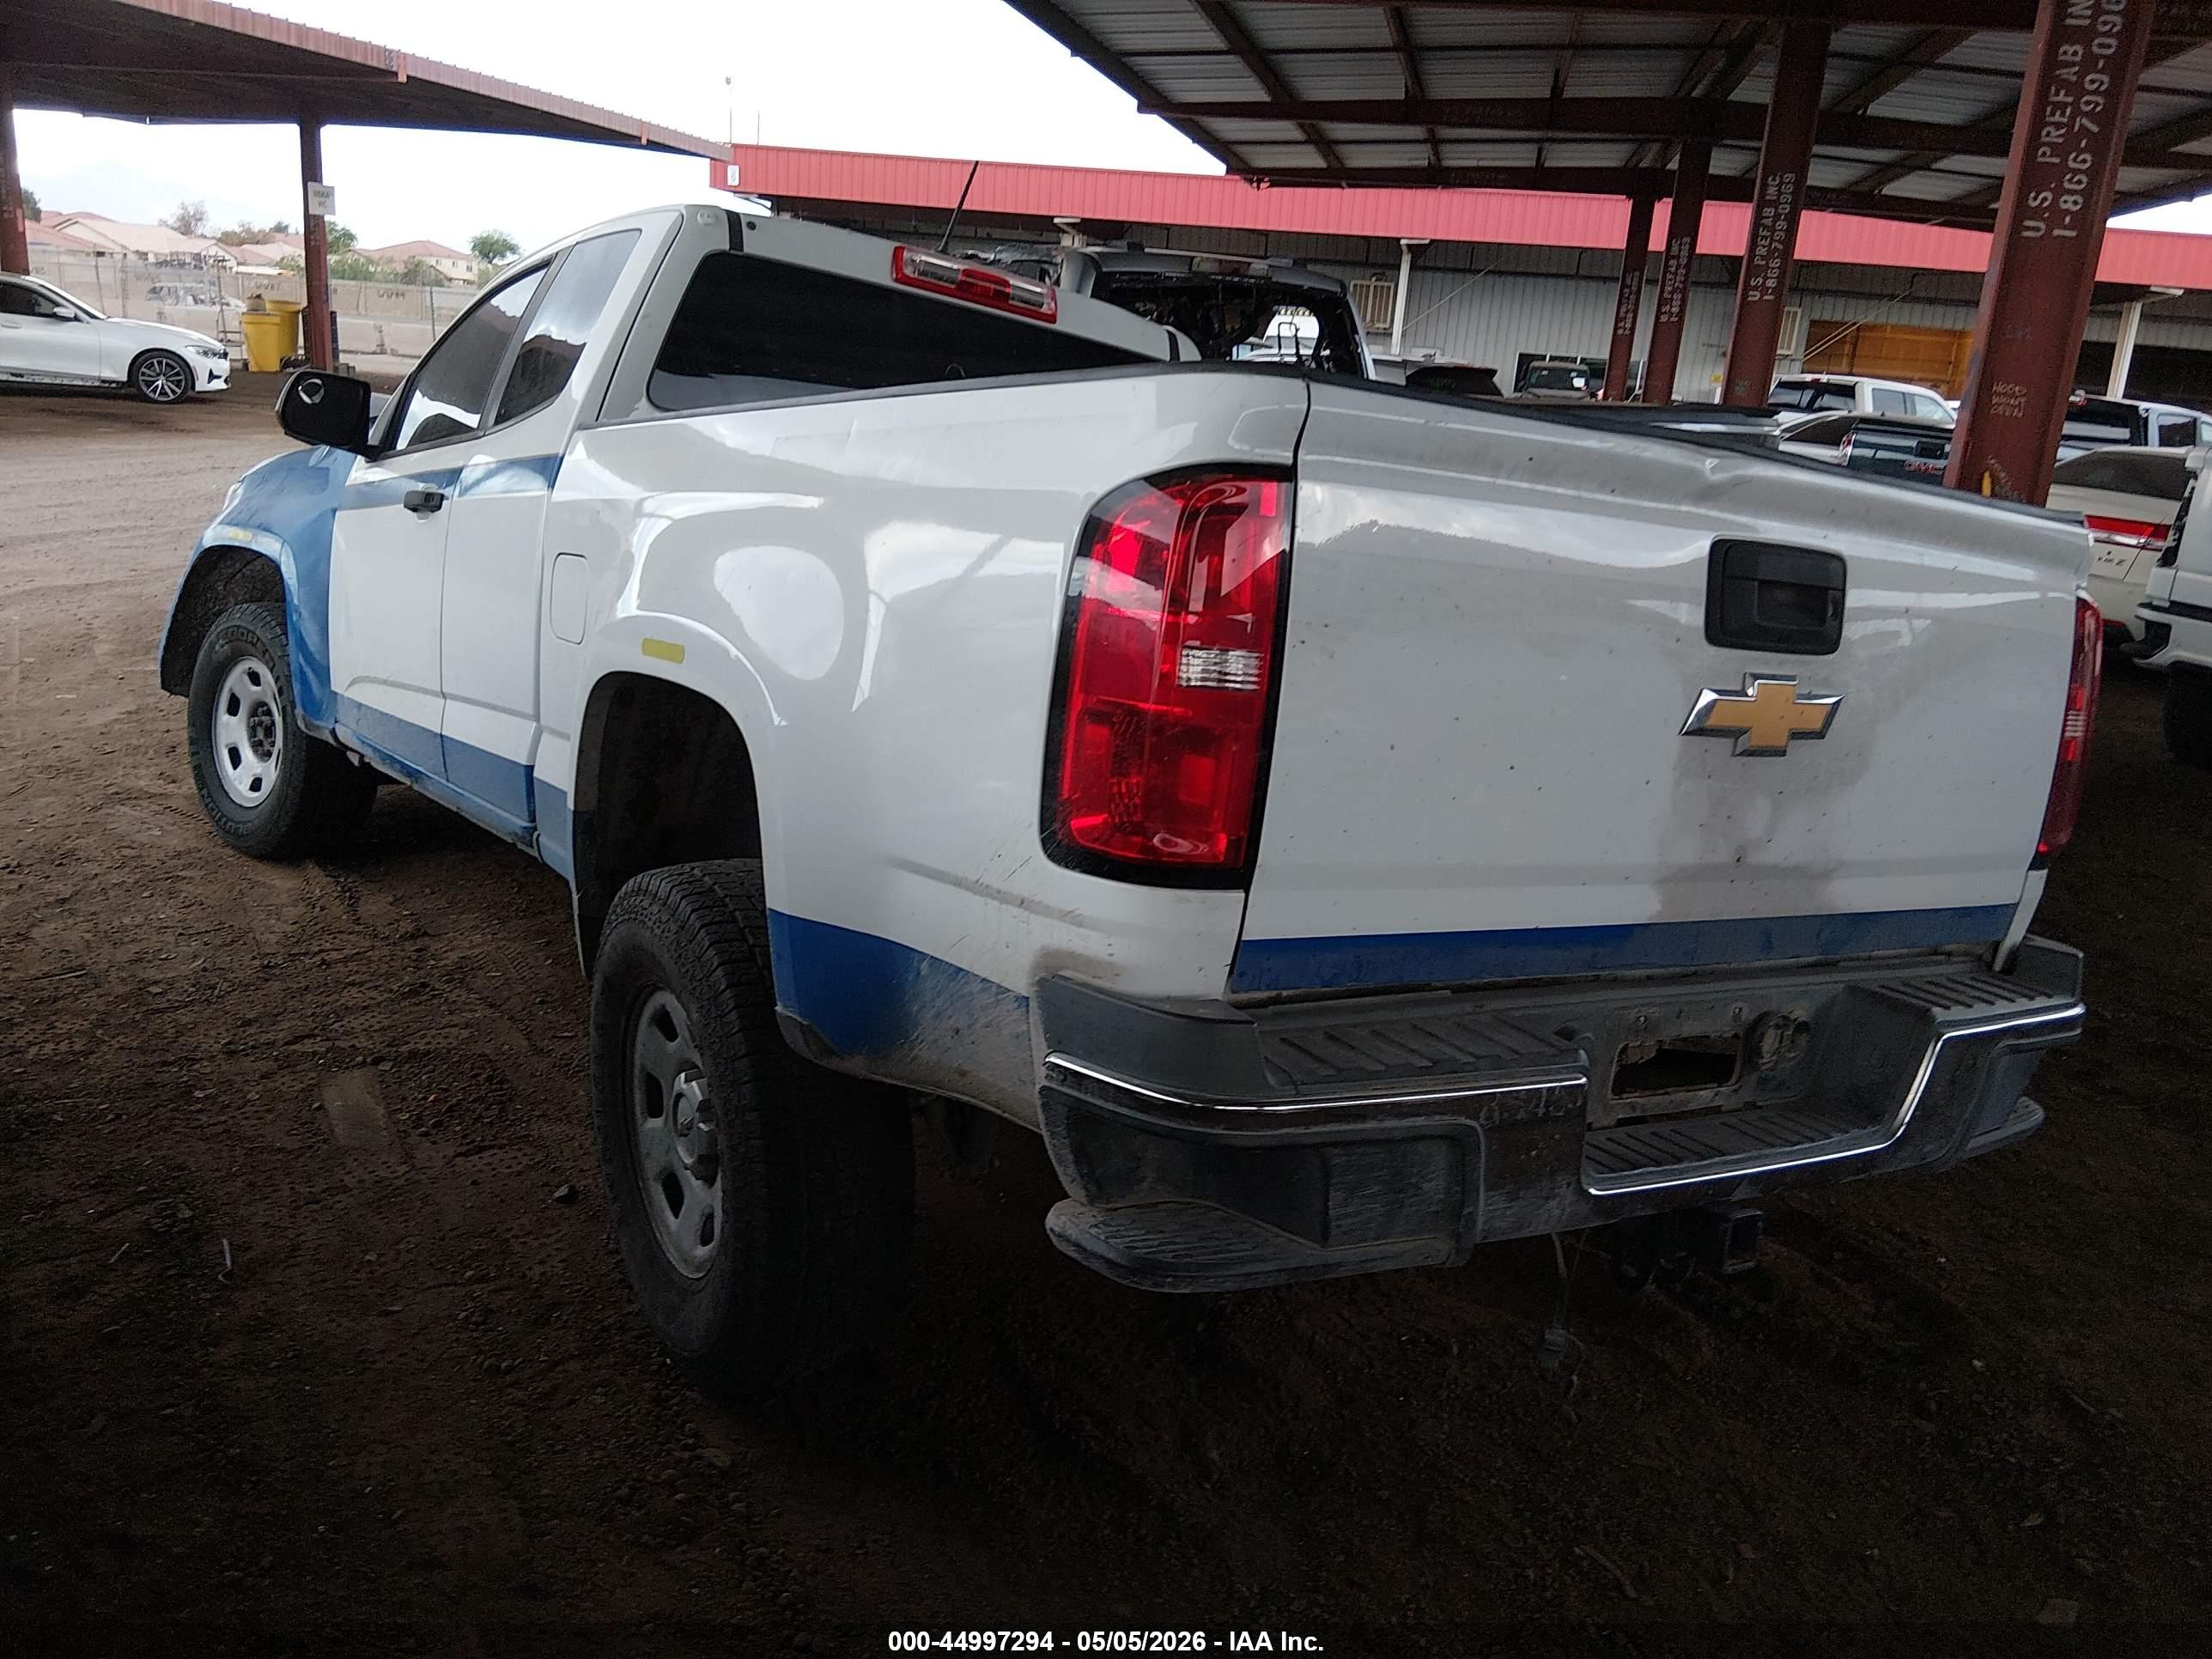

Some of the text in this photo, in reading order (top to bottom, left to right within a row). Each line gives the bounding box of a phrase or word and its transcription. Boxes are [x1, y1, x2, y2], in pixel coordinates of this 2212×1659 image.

[2037, 44, 2084, 163] PREFAB
[1747, 172, 1782, 301] U.S. PREFAB INC.
[1763, 173, 1796, 301] 1-866-799-0969
[2020, 181, 2056, 238] U.S.
